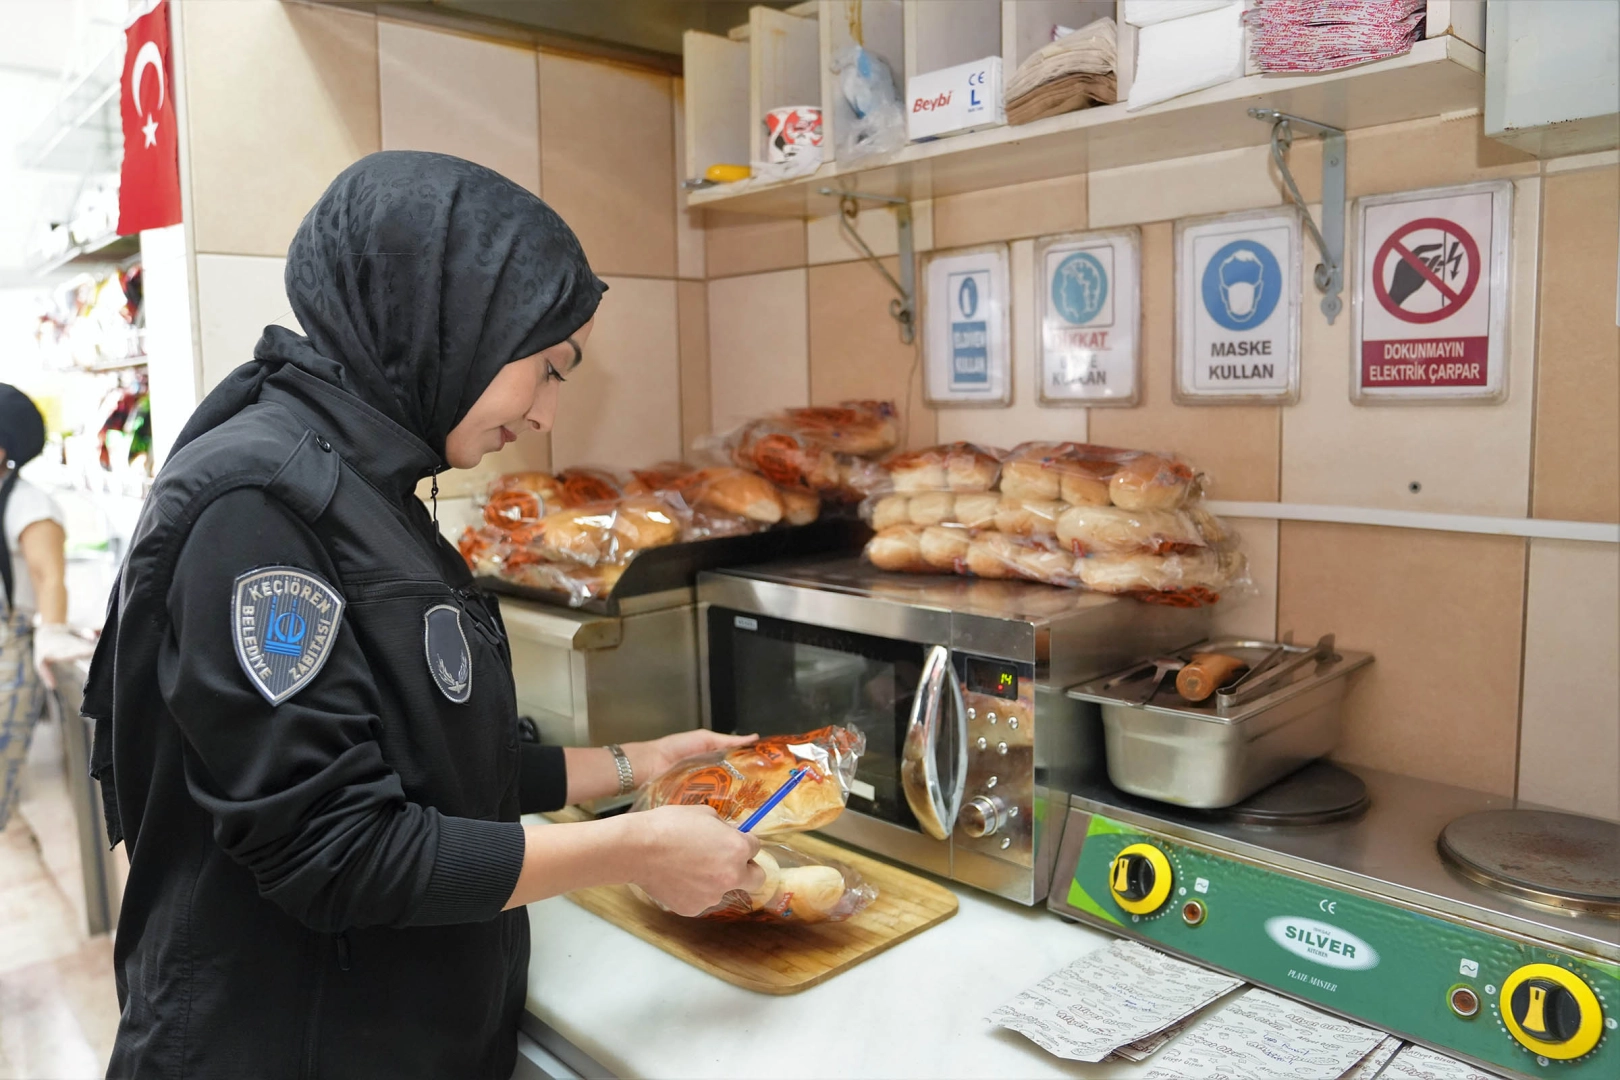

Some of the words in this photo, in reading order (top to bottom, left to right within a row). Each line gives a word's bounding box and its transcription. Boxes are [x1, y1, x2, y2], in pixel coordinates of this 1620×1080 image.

[912, 90, 953, 113] Beybi
[971, 89, 981, 106] L
[1211, 340, 1272, 357] MASKE
[1384, 341, 1465, 359] DOKUNMAYIN
[1208, 364, 1274, 380] KULLAN
[1369, 361, 1426, 380] ELEKTRİK
[1428, 363, 1480, 384] ÇARPAR
[249, 576, 331, 614] KEÇİÖREN
[242, 605, 273, 680] BELEDİYE
[288, 618, 331, 681] ZABITASI
[1000, 673, 1013, 685] 14
[1285, 925, 1357, 959] SILVER
[1307, 947, 1328, 958] KITCHEN
[1287, 969, 1308, 983] PLATE
[1310, 976, 1338, 992] MASTER
